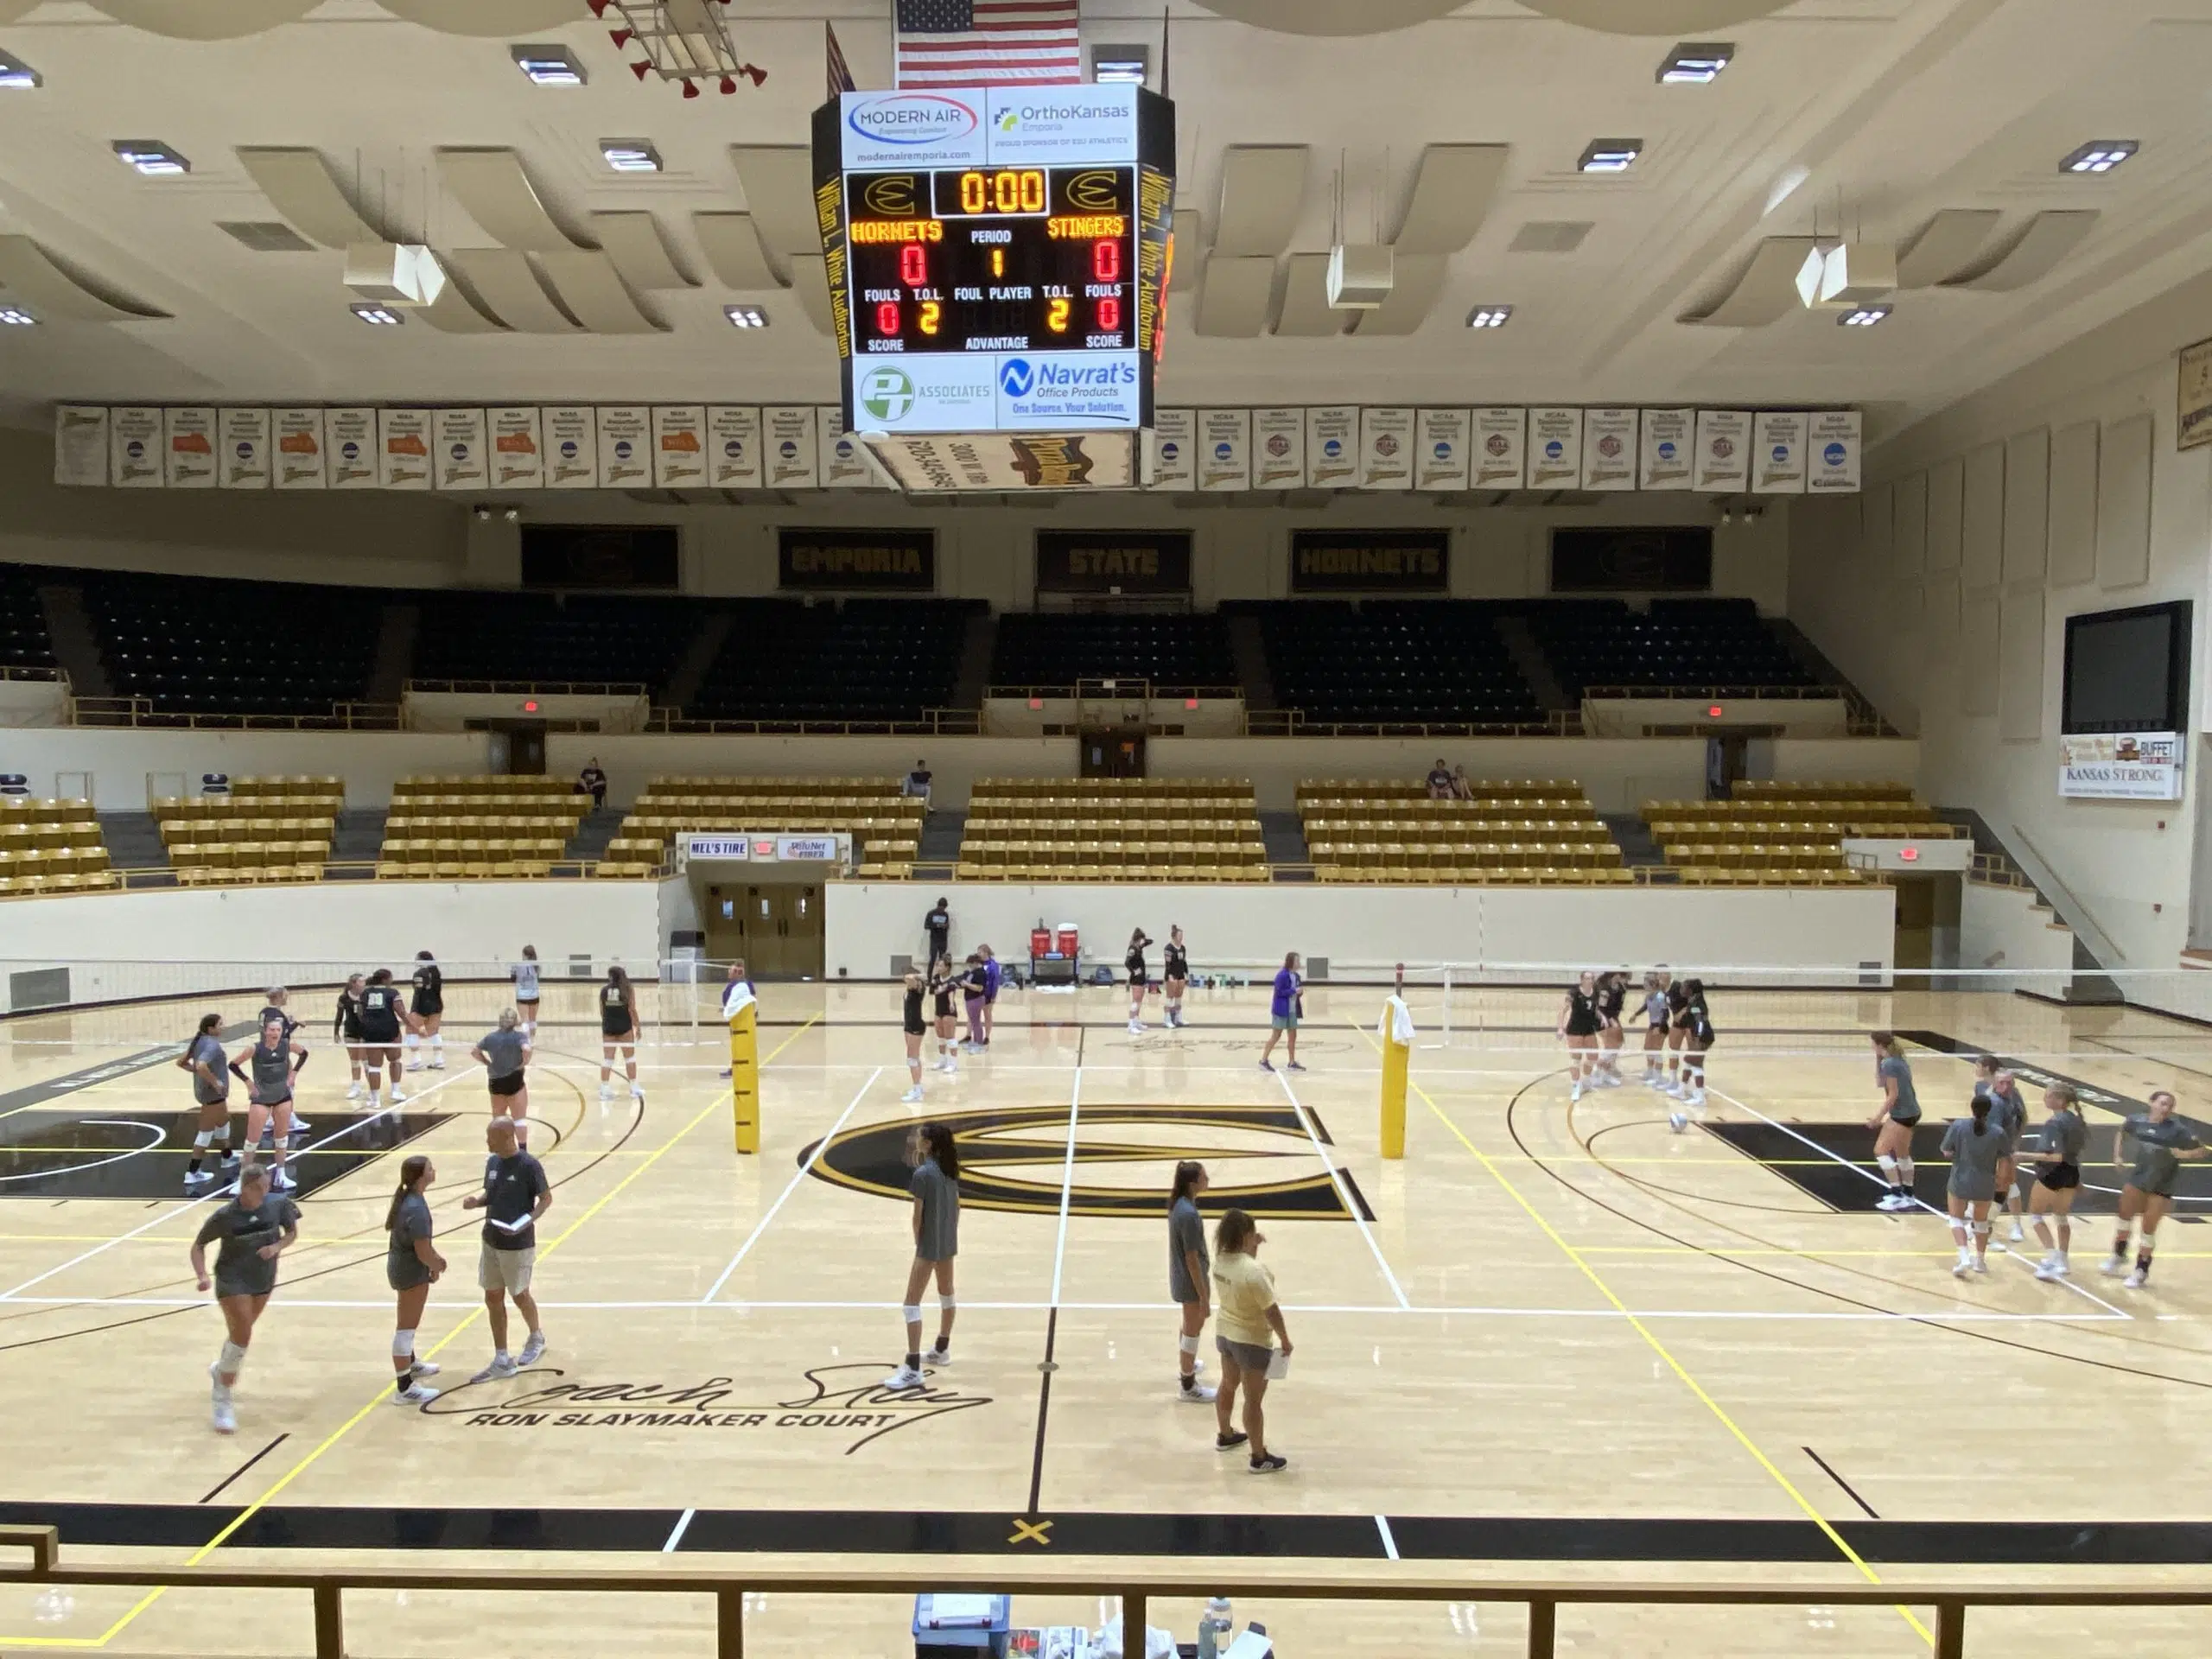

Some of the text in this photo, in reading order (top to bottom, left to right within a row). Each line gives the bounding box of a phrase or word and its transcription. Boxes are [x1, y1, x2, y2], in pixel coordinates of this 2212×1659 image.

[861, 109, 961, 124] MODERN AIR
[1021, 105, 1129, 120] OrthoKansas
[1022, 123, 1063, 132] Emporia
[858, 150, 970, 162] modernairemporia.com
[960, 171, 1044, 213] 0:00
[1141, 171, 1173, 219] William
[851, 220, 942, 244] HORNETS
[1047, 216, 1123, 238] STINGERS
[1141, 220, 1166, 232] L.
[971, 230, 1011, 243] PERIOD
[901, 243, 925, 286] 0
[992, 248, 1002, 278] 1
[1095, 240, 1120, 283] 0
[1141, 239, 1165, 277] White
[816, 176, 851, 359] William L. White Auditorium
[865, 288, 944, 302] FOULS T.O.L.
[955, 286, 1032, 301] FOUL PLAYER
[1042, 283, 1122, 298] T.O.L. FOULS
[877, 302, 899, 334] 0
[919, 302, 940, 335] 2
[1048, 300, 1069, 333] 2
[1097, 298, 1119, 331] 0
[1140, 278, 1160, 351] Auditorium
[868, 339, 904, 352] SCORE
[965, 336, 1028, 350] ADVANTAGE
[1086, 334, 1122, 348] SCORE
[1039, 361, 1135, 385] Navrat's
[918, 385, 990, 397] ASSOCIATES
[1037, 386, 1119, 397] Office Products
[1013, 402, 1029, 414] One
[1065, 402, 1085, 413] Your
[1088, 401, 1127, 413] Solution.
[792, 546, 922, 574] EMPORIA
[1069, 548, 1160, 575] STATE
[1300, 548, 1440, 575] HORNETS
[2067, 768, 2164, 781] KANSAS STRONG
[691, 842, 746, 855] MEL'S TIRE
[467, 1413, 896, 1427] RON SLAYMAKER COURT
